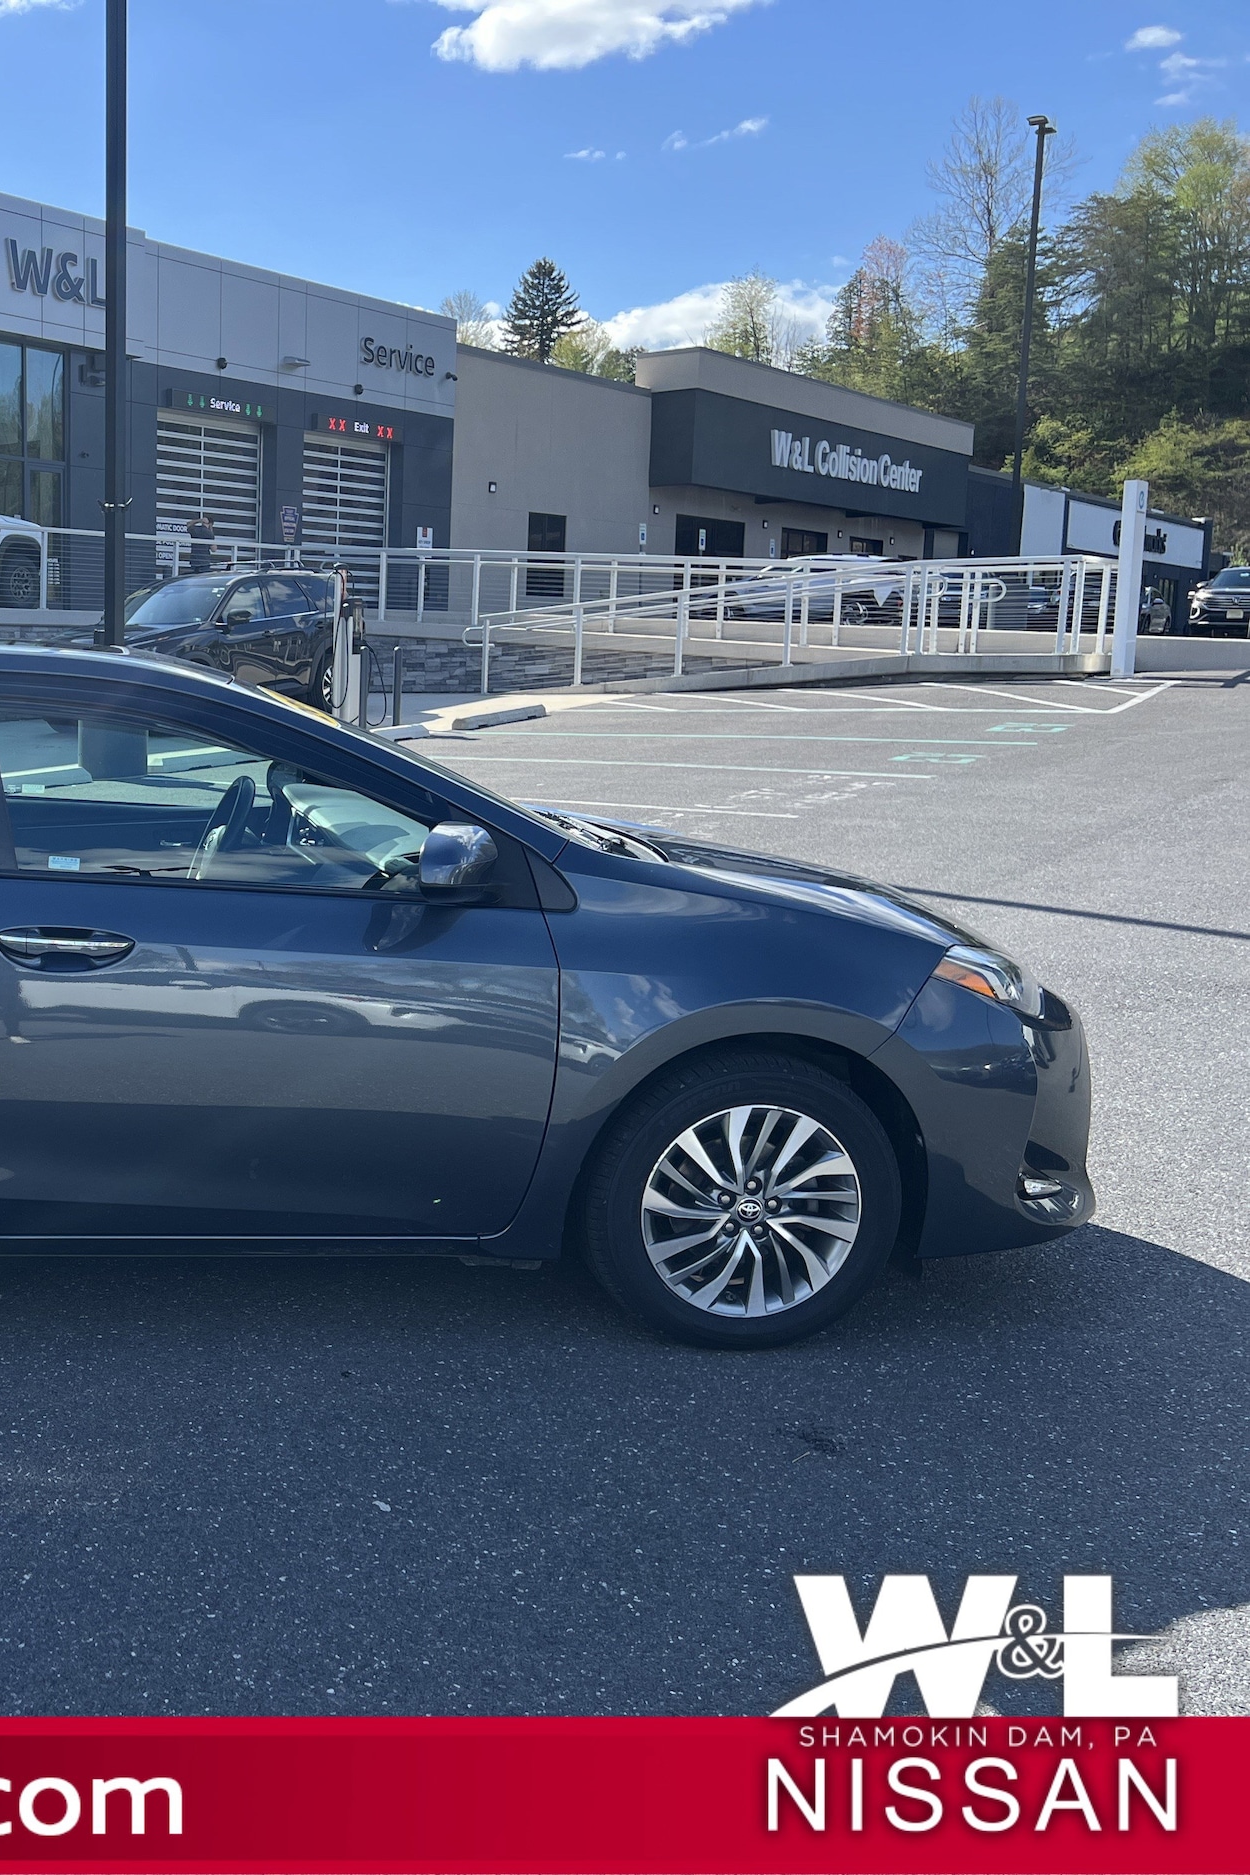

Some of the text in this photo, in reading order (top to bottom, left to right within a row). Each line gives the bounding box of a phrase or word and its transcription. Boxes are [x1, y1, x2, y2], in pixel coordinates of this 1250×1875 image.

[6, 237, 105, 309] W&L
[361, 337, 435, 376] Service
[210, 398, 241, 412] Service
[354, 422, 369, 434] Exit
[771, 429, 923, 493] W&L Collision Center
